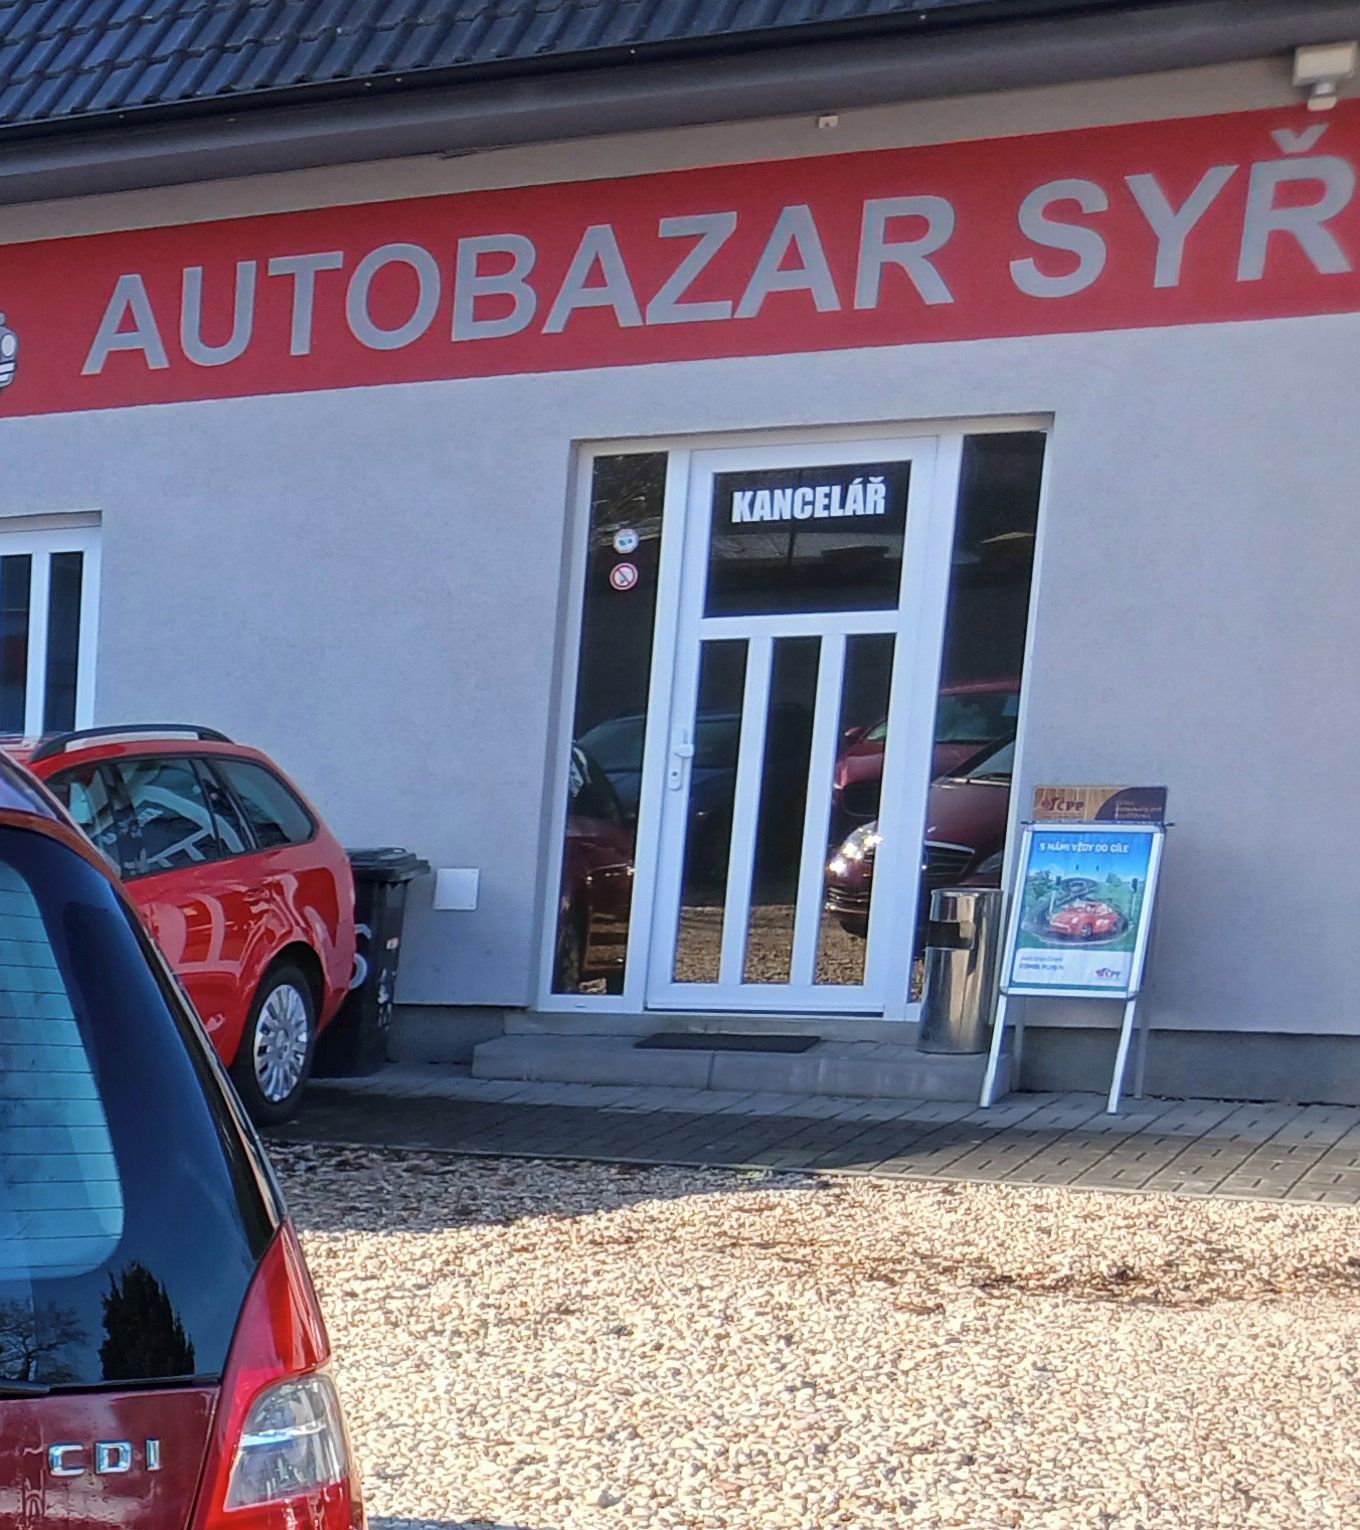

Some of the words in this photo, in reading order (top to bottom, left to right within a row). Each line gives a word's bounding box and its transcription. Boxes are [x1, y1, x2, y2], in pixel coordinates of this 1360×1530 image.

[81, 194, 957, 376] AUTOBAZAR
[1011, 122, 1357, 300] SYŘ
[731, 476, 886, 523] KANCELÁŘ
[48, 1437, 161, 1477] CDI
